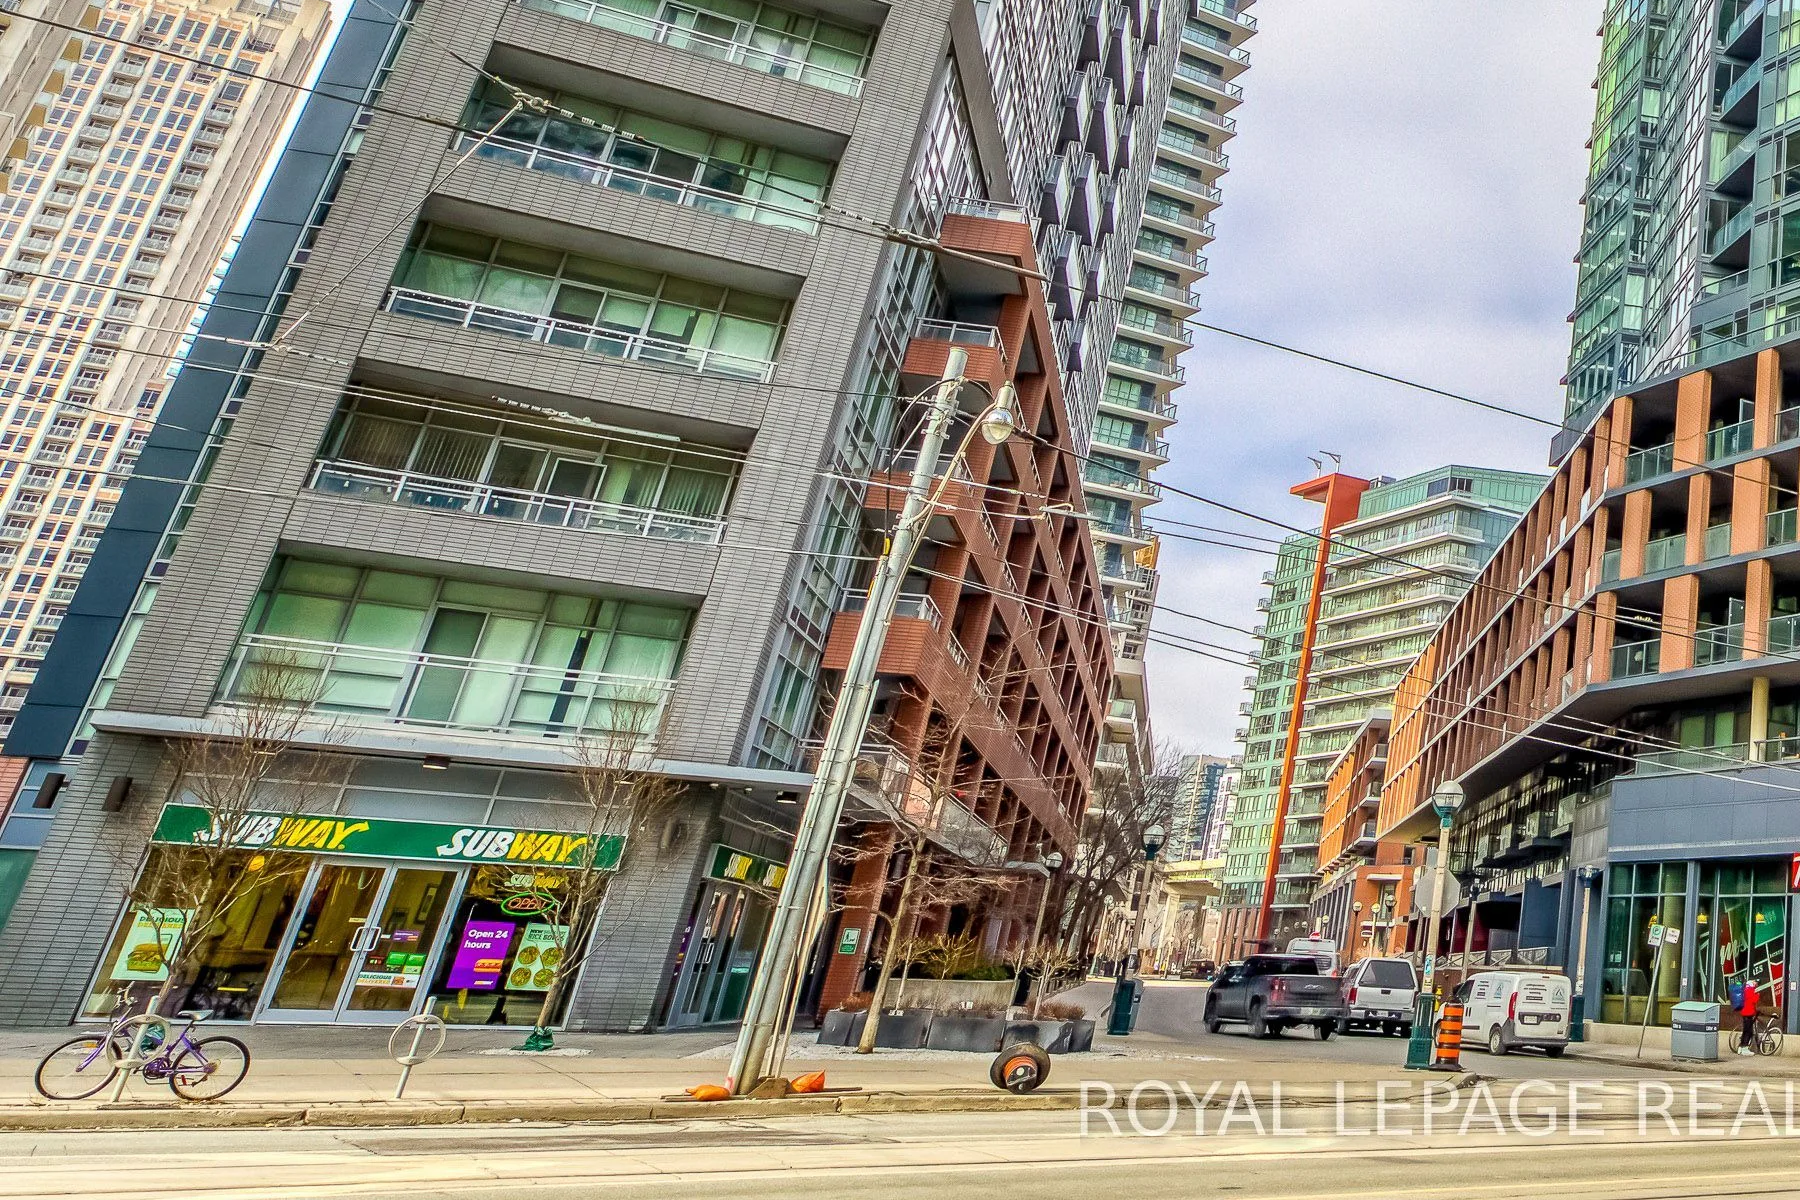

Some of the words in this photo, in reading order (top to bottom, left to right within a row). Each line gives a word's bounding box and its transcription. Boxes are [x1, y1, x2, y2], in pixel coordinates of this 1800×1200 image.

[437, 828, 592, 862] SUBWAY
[468, 929, 493, 939] Open
[495, 930, 508, 939] 24
[464, 940, 491, 949] hours
